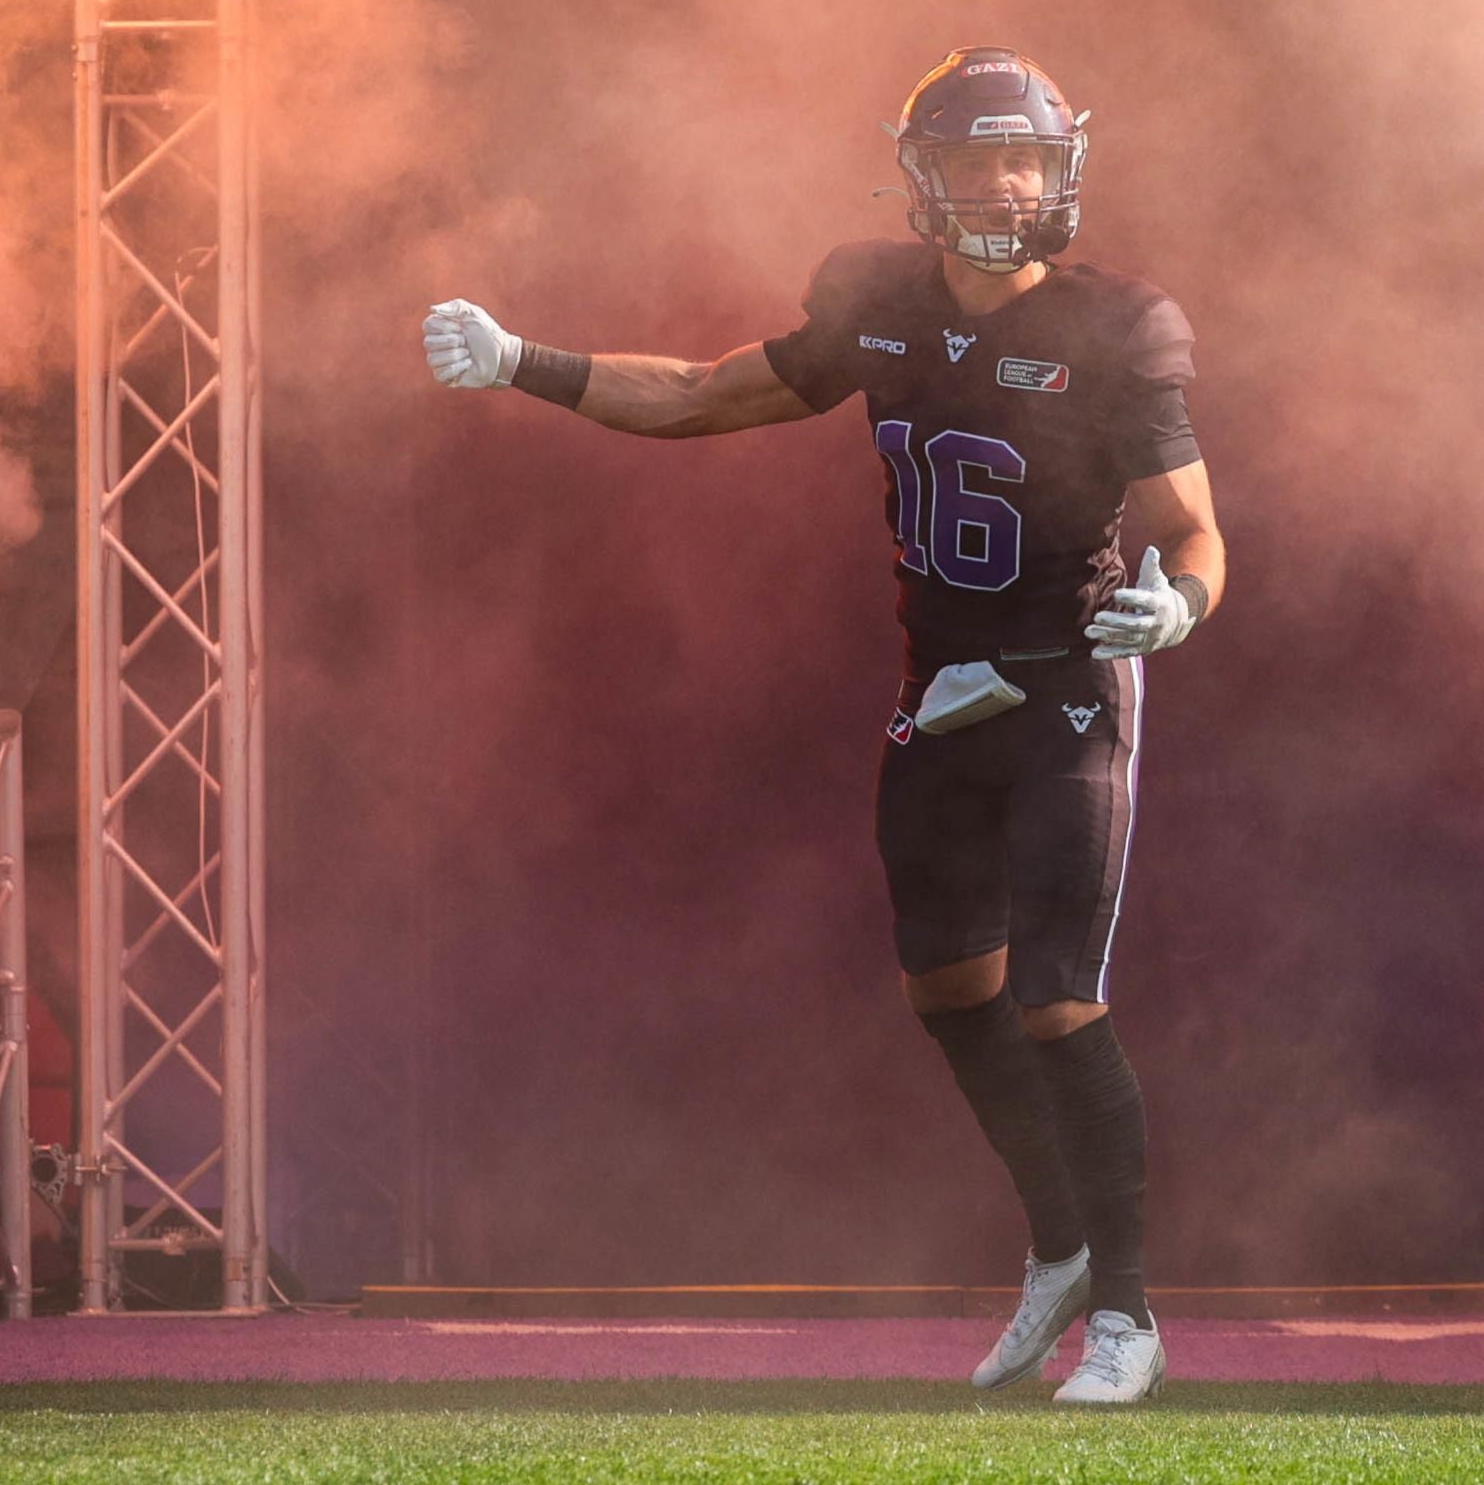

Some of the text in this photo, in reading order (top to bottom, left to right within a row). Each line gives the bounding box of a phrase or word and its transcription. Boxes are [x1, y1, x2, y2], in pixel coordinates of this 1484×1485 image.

[1005, 363, 1038, 372] EUROPEAN
[1004, 369, 1026, 377] LEAGUE
[1004, 375, 1034, 384] FOOTBALL
[876, 420, 1026, 592] 16
